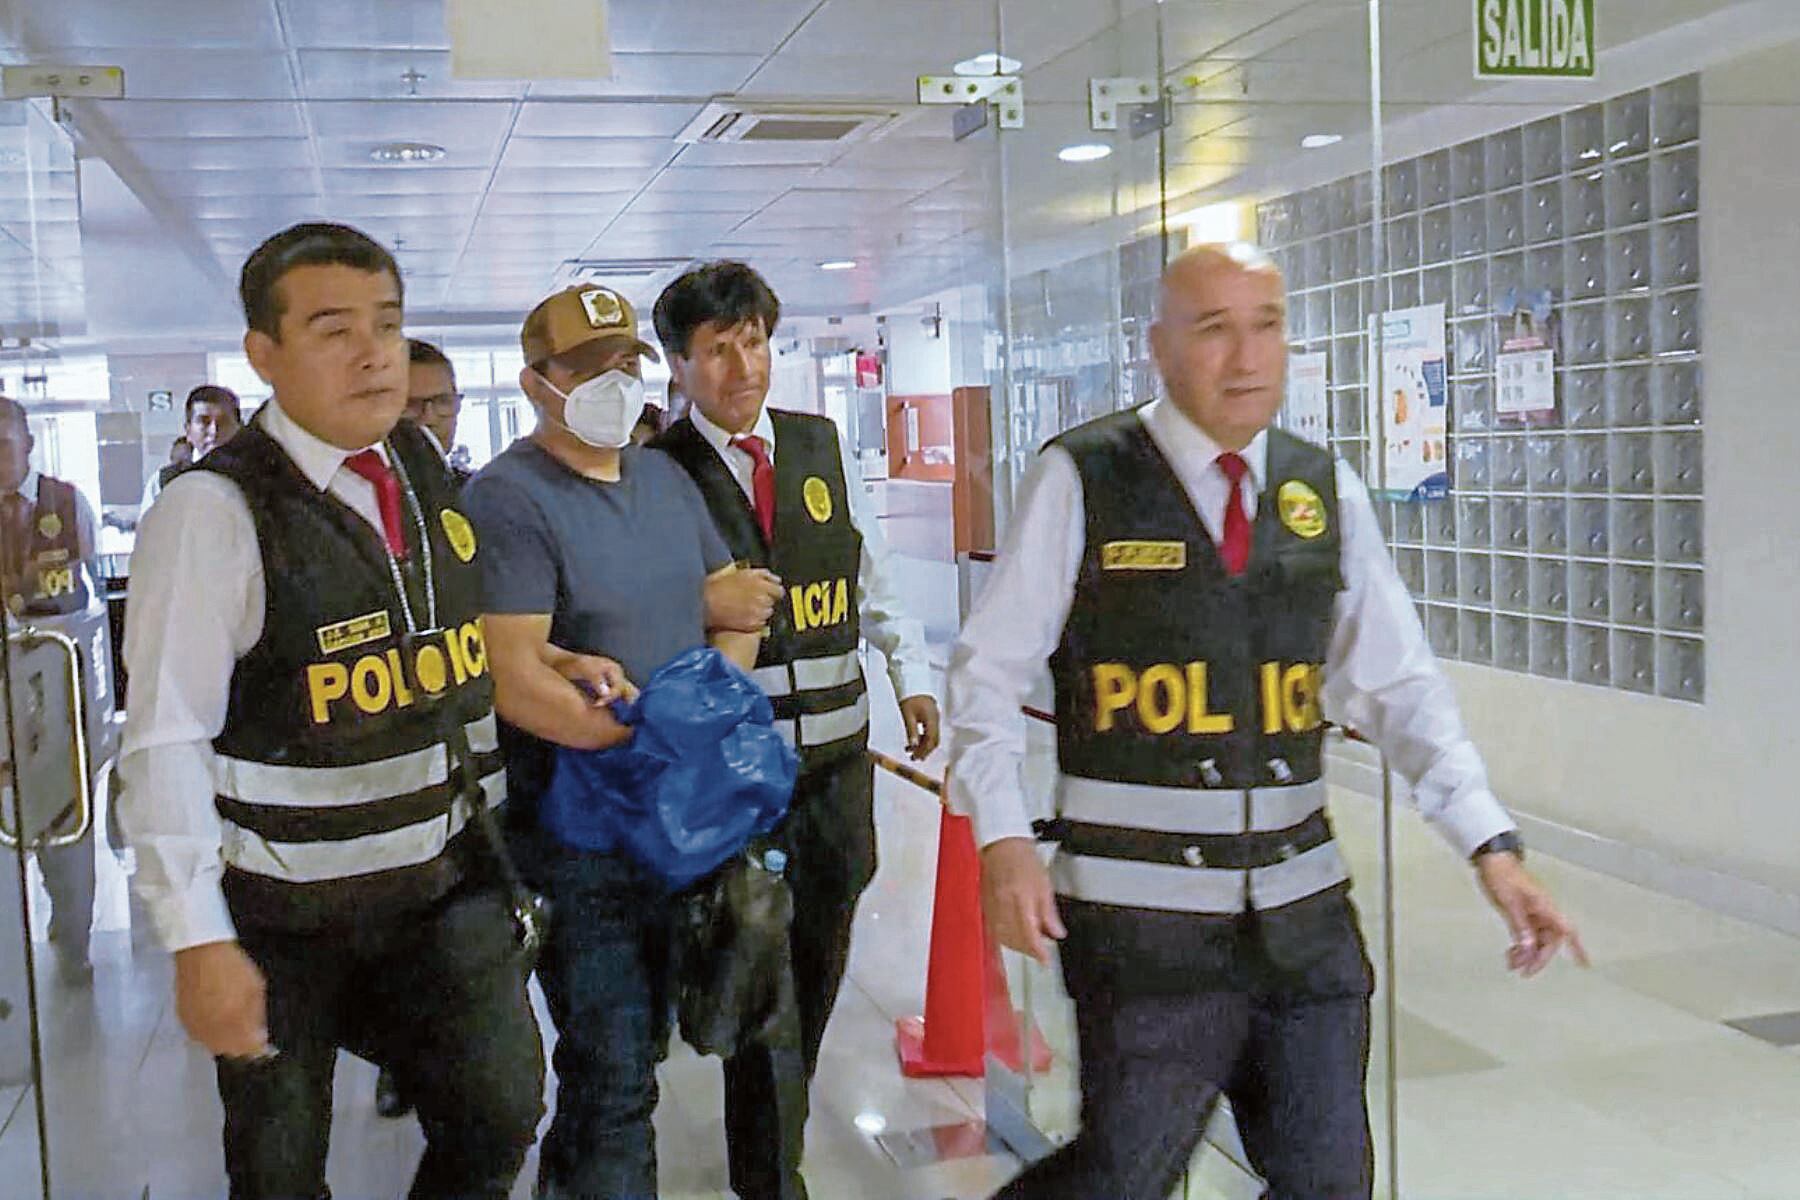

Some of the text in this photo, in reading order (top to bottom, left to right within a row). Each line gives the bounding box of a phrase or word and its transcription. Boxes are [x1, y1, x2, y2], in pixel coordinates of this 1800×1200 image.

[1482, 0, 1590, 68] SALIDA
[151, 392, 172, 411] S
[307, 648, 414, 723] POL
[1092, 660, 1234, 734] POL
